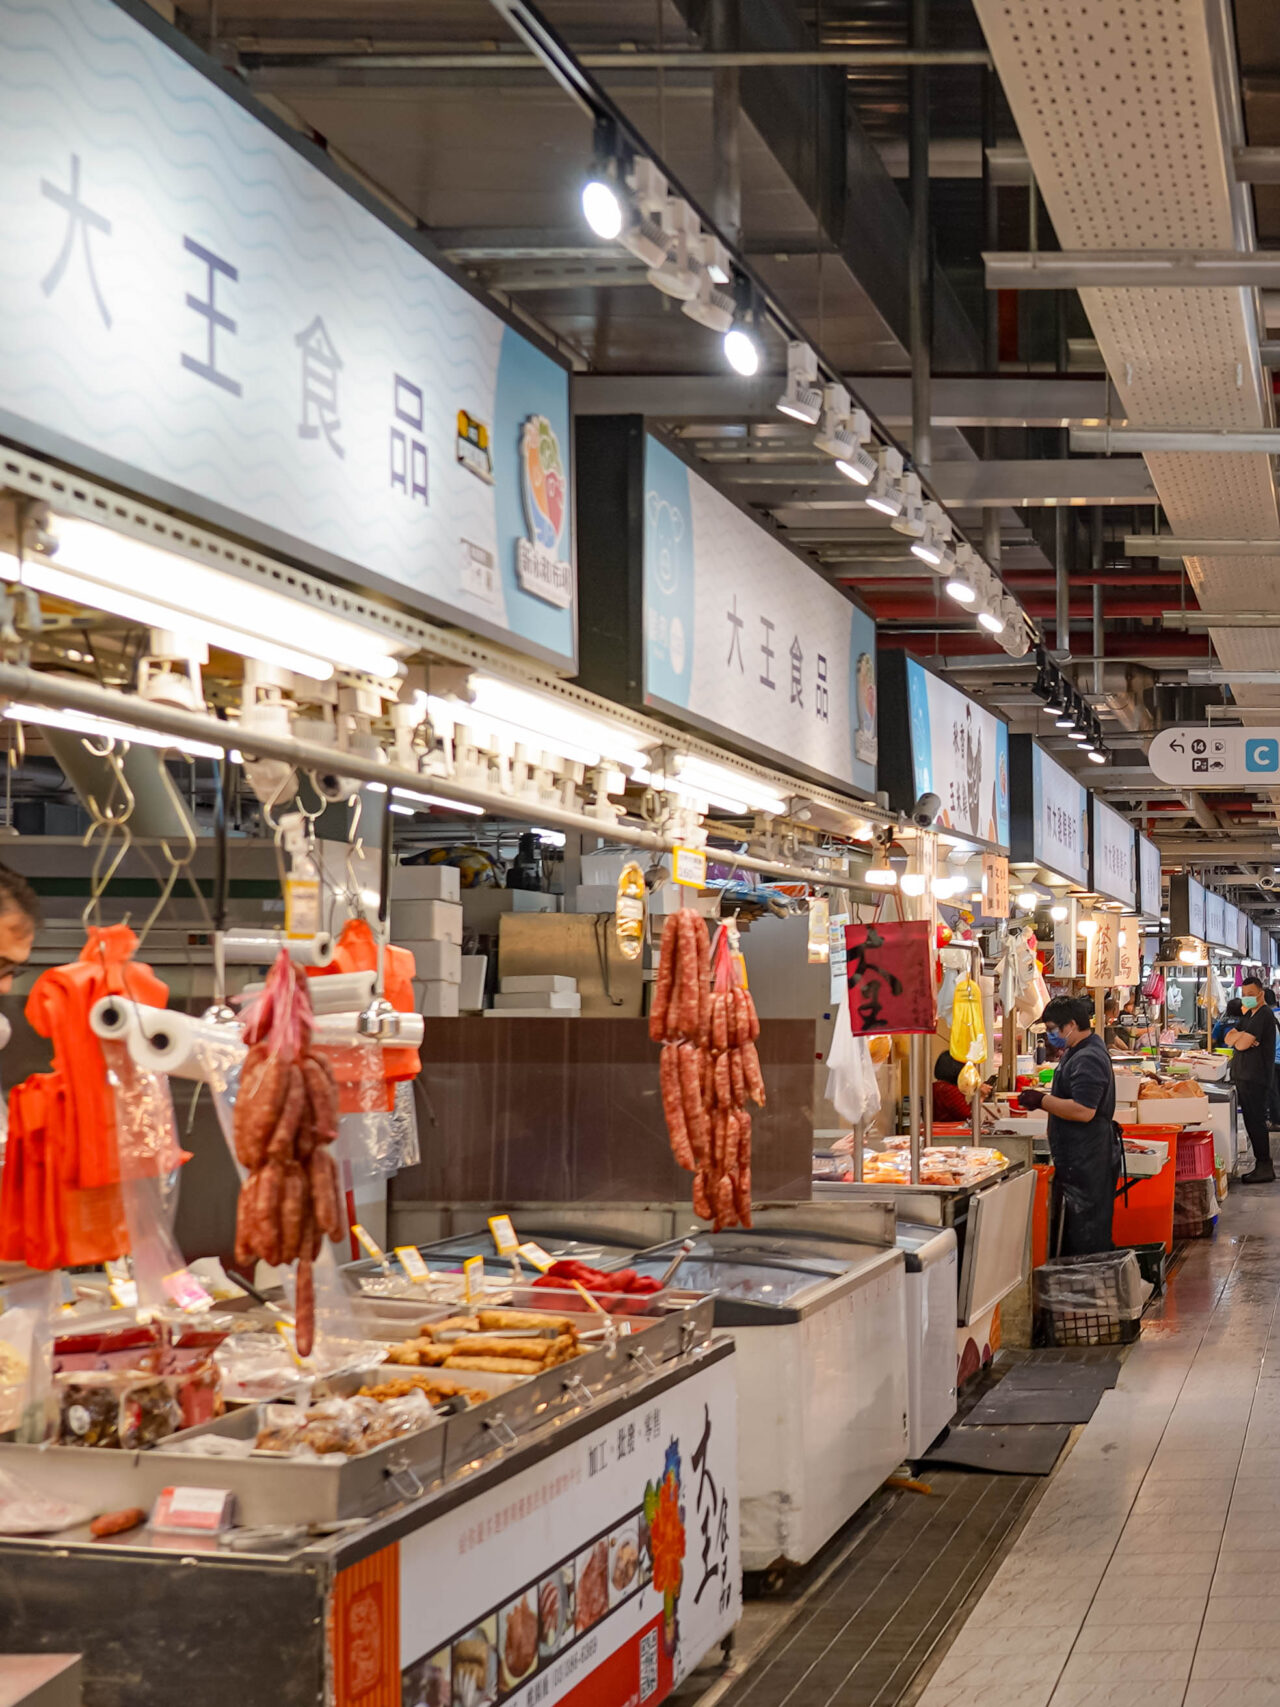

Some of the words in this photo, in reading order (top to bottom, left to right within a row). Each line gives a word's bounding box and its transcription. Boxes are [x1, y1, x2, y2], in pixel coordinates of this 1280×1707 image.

[40, 152, 430, 506] 大王食品
[727, 594, 829, 724] 大王食品
[1253, 745, 1271, 766] C
